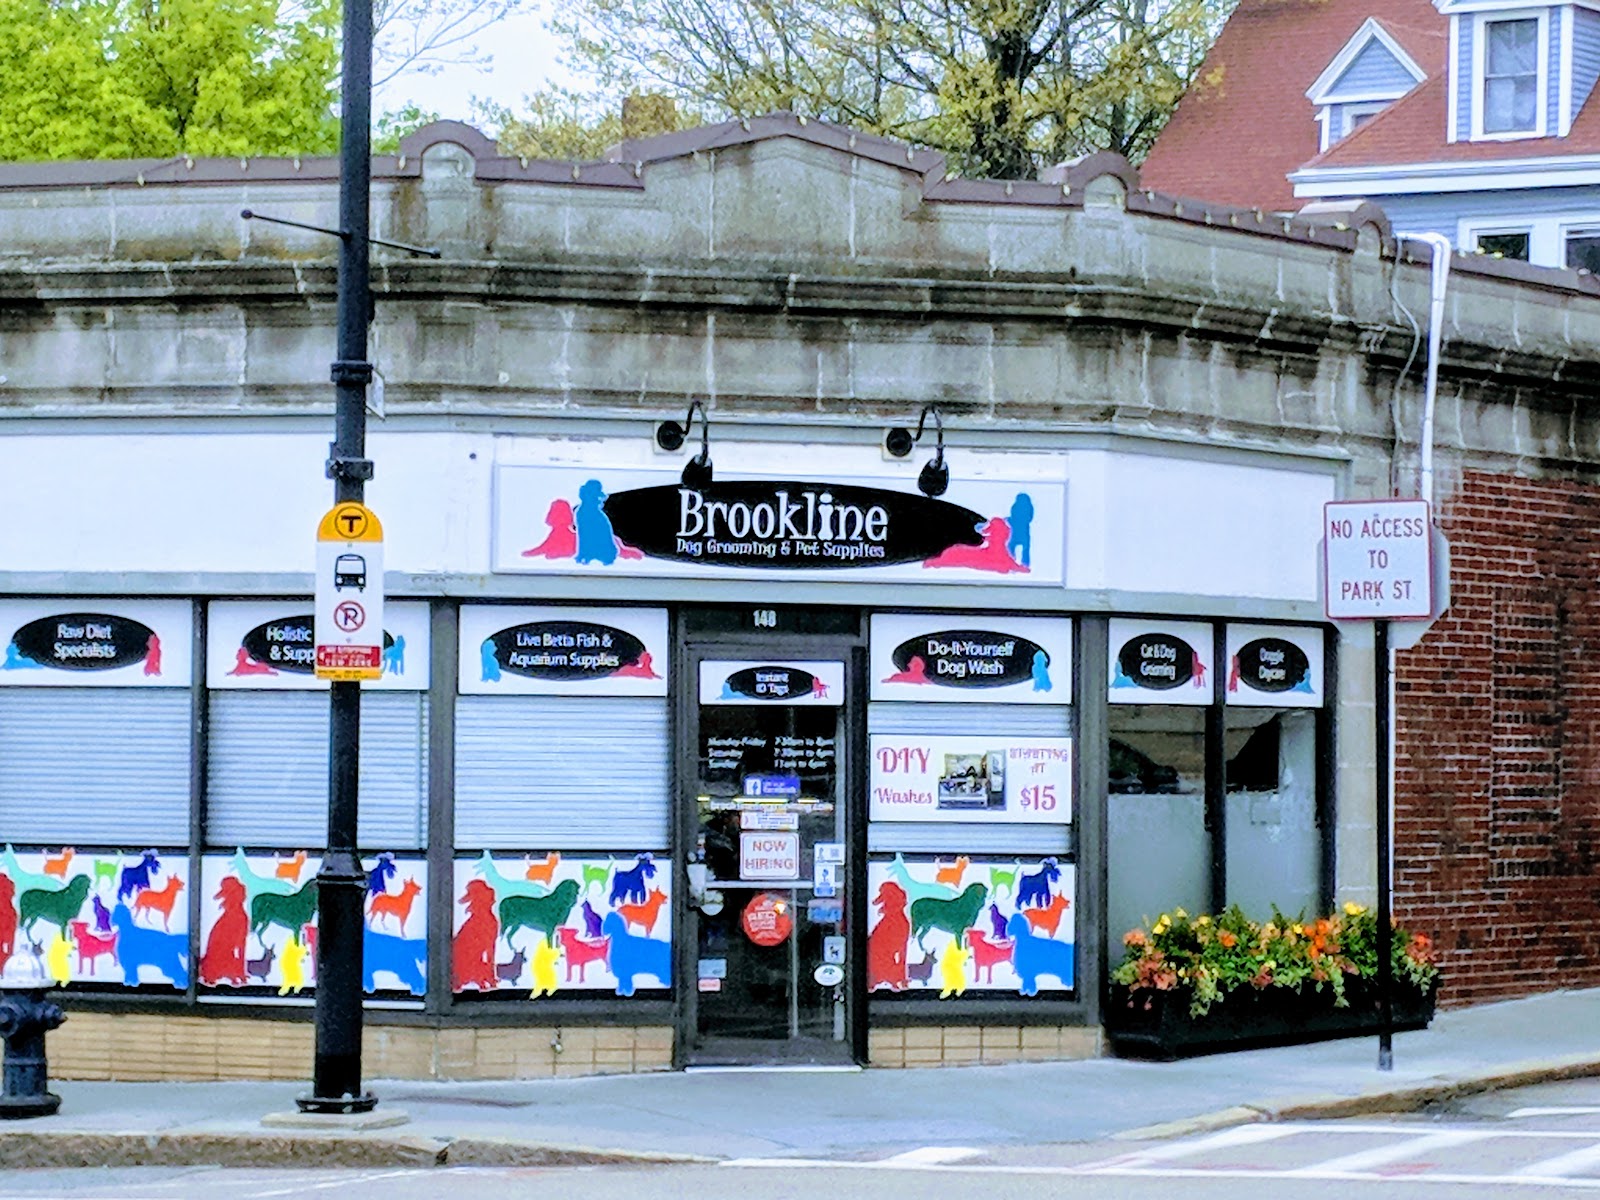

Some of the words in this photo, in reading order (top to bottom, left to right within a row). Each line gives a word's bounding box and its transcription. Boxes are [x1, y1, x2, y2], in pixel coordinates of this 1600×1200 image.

[341, 515, 362, 533] T
[676, 489, 888, 541] Brookline
[1331, 519, 1352, 539] NO
[1361, 518, 1424, 538] ACCESS
[676, 538, 702, 556] Dog
[707, 539, 777, 558] Grooming
[780, 541, 791, 555] &
[795, 541, 820, 556] Pet
[823, 542, 885, 560] Supplies
[1368, 549, 1388, 569] TO
[1341, 581, 1384, 600] PARK
[1393, 580, 1412, 600] ST
[57, 623, 84, 639] Raw
[85, 623, 112, 640] Diet
[266, 625, 313, 642] Holistic
[516, 633, 541, 647] Live
[543, 633, 574, 648] Betta
[576, 634, 599, 647] Fish
[601, 633, 613, 648] &
[54, 641, 117, 661] Specialists
[269, 645, 281, 660] &
[283, 645, 316, 663] Supp
[509, 651, 568, 668] Aquarium
[569, 651, 619, 670] Supplies
[937, 658, 966, 678] Dog
[968, 659, 1004, 675] Wash
[876, 747, 931, 775] DIY
[874, 786, 933, 805] Washes
[1020, 784, 1057, 811] $15
[752, 840, 787, 852] NOW
[745, 858, 794, 870] HIRING
